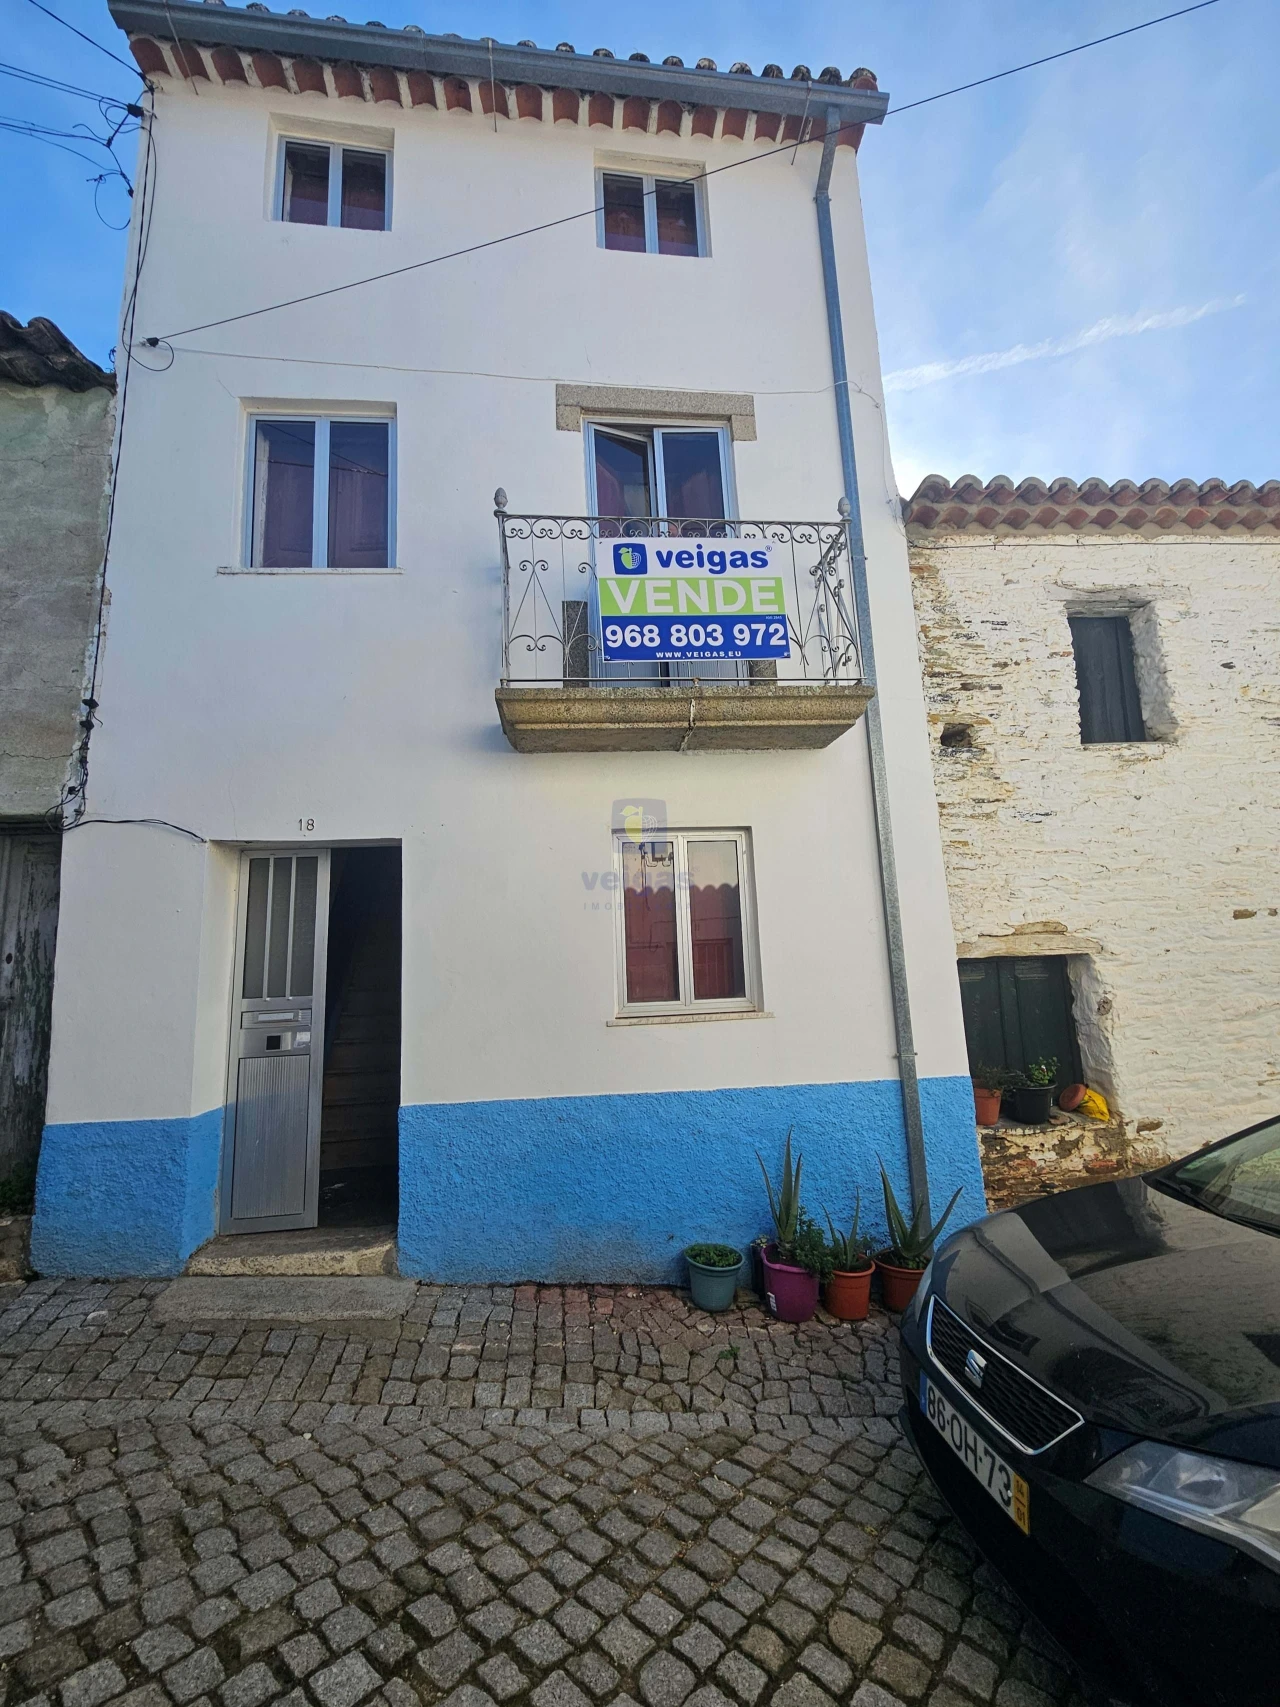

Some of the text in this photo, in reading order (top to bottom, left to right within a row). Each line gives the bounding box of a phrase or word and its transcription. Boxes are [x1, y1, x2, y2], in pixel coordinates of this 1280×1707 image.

[655, 544, 769, 575] veigas
[606, 579, 779, 614] VENDE
[605, 622, 787, 648] 968 803 972
[655, 651, 742, 659] WWW.VEIGAS.EU
[298, 818, 315, 831] 18
